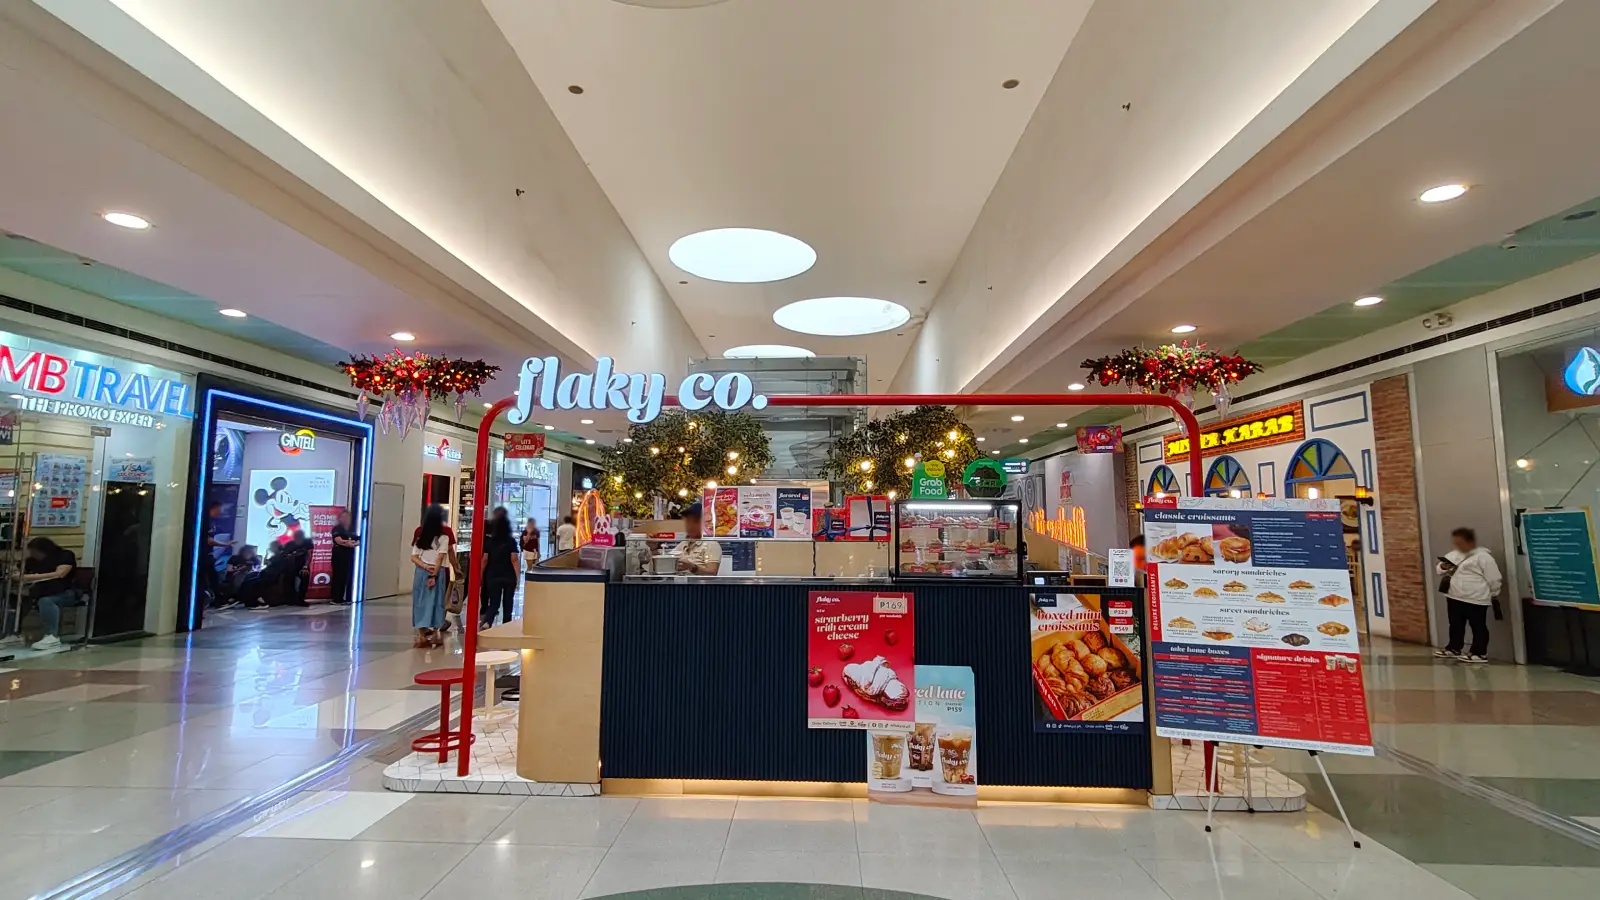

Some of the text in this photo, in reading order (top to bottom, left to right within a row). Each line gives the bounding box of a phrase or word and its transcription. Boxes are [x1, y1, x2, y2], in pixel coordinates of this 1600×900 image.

[70, 359, 194, 418] TRAVEL
[507, 355, 768, 425] flaky co.
[20, 397, 156, 428] THE PROMO EXPERT
[281, 433, 315, 450] GINTELL
[920, 478, 942, 486] Grab
[920, 487, 942, 495] Food
[1154, 512, 1237, 521] classic croissants
[815, 614, 869, 623] strawberry
[1036, 609, 1102, 620] boxed mini
[816, 622, 868, 632] with cream
[1038, 622, 1101, 631] croissants
[827, 632, 859, 640] cheese
[1256, 653, 1320, 663] signature drinks
[937, 685, 966, 699] latte
